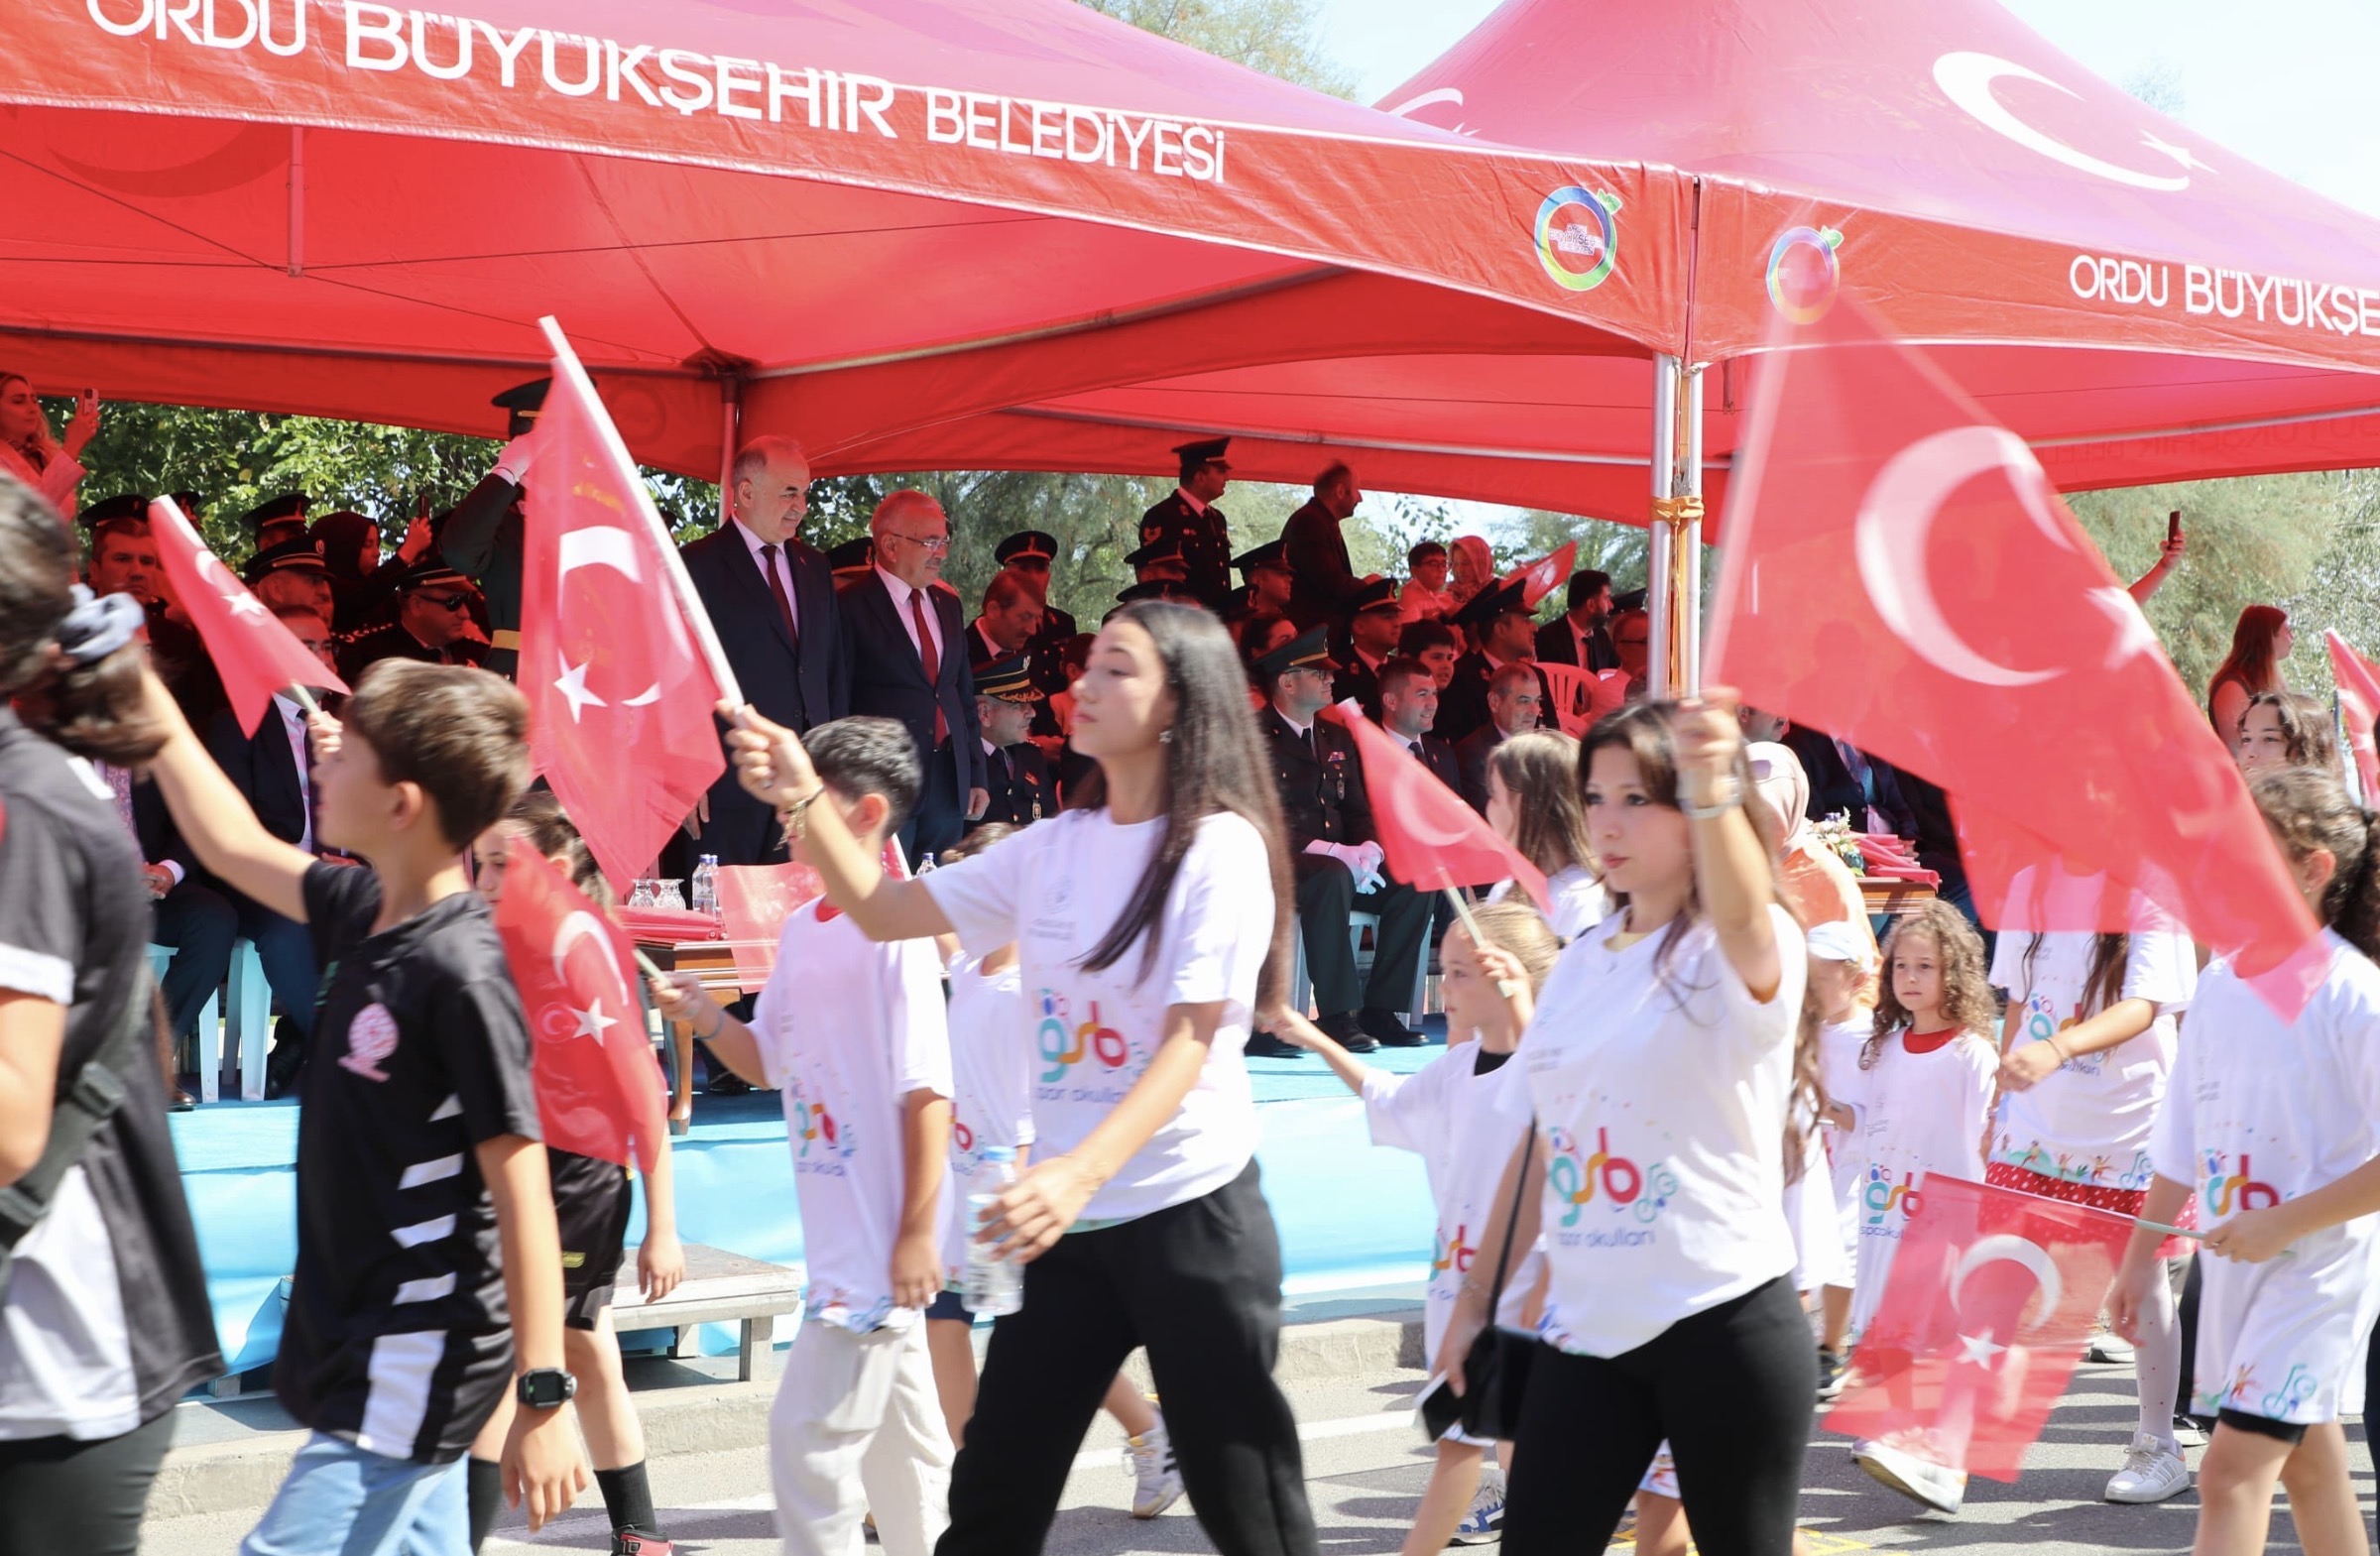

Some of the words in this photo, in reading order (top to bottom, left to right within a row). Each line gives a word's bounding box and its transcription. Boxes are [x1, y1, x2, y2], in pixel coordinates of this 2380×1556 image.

[86, 0, 306, 57] ORDU
[2070, 255, 2169, 307] ORDU
[2185, 264, 2380, 337] BÜYÜKŞE
